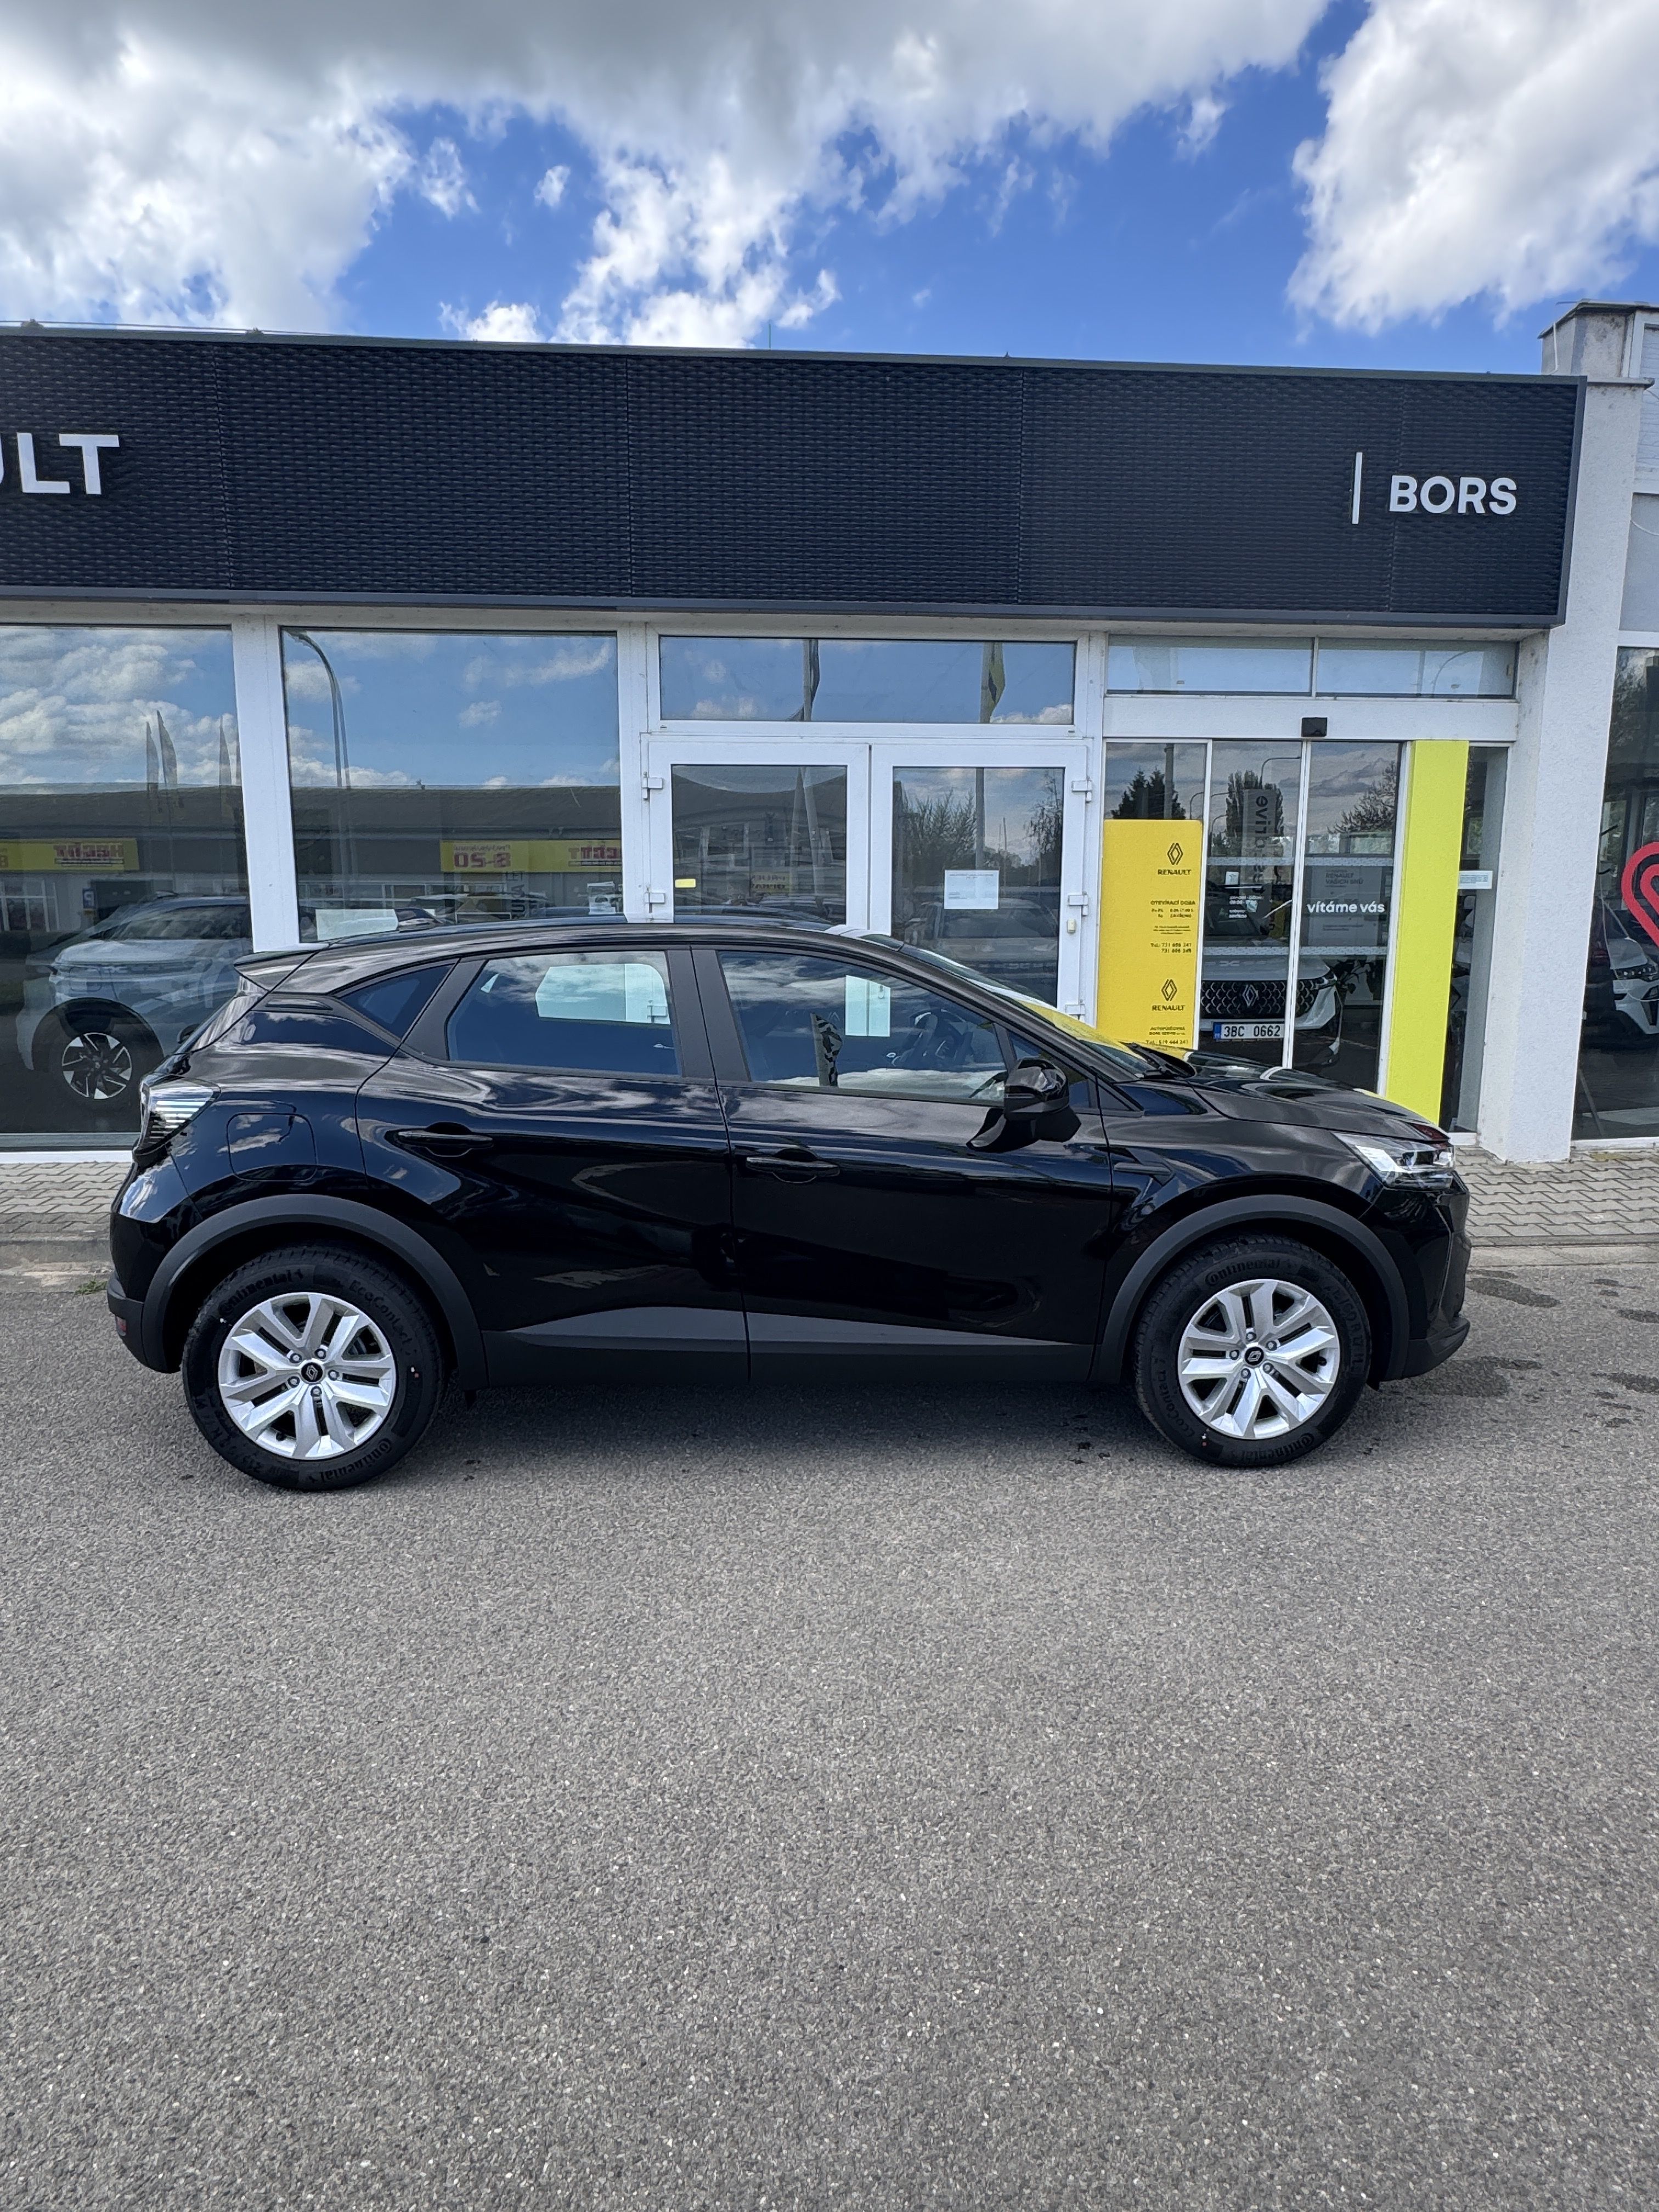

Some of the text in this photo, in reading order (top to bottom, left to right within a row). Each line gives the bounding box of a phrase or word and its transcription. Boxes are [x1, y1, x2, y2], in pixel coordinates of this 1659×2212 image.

[0, 433, 120, 495] LT
[1389, 475, 1517, 515] BORS
[1307, 901, 1385, 913] vítáme vás
[1223, 1025, 1280, 1037] 3BC 0662
